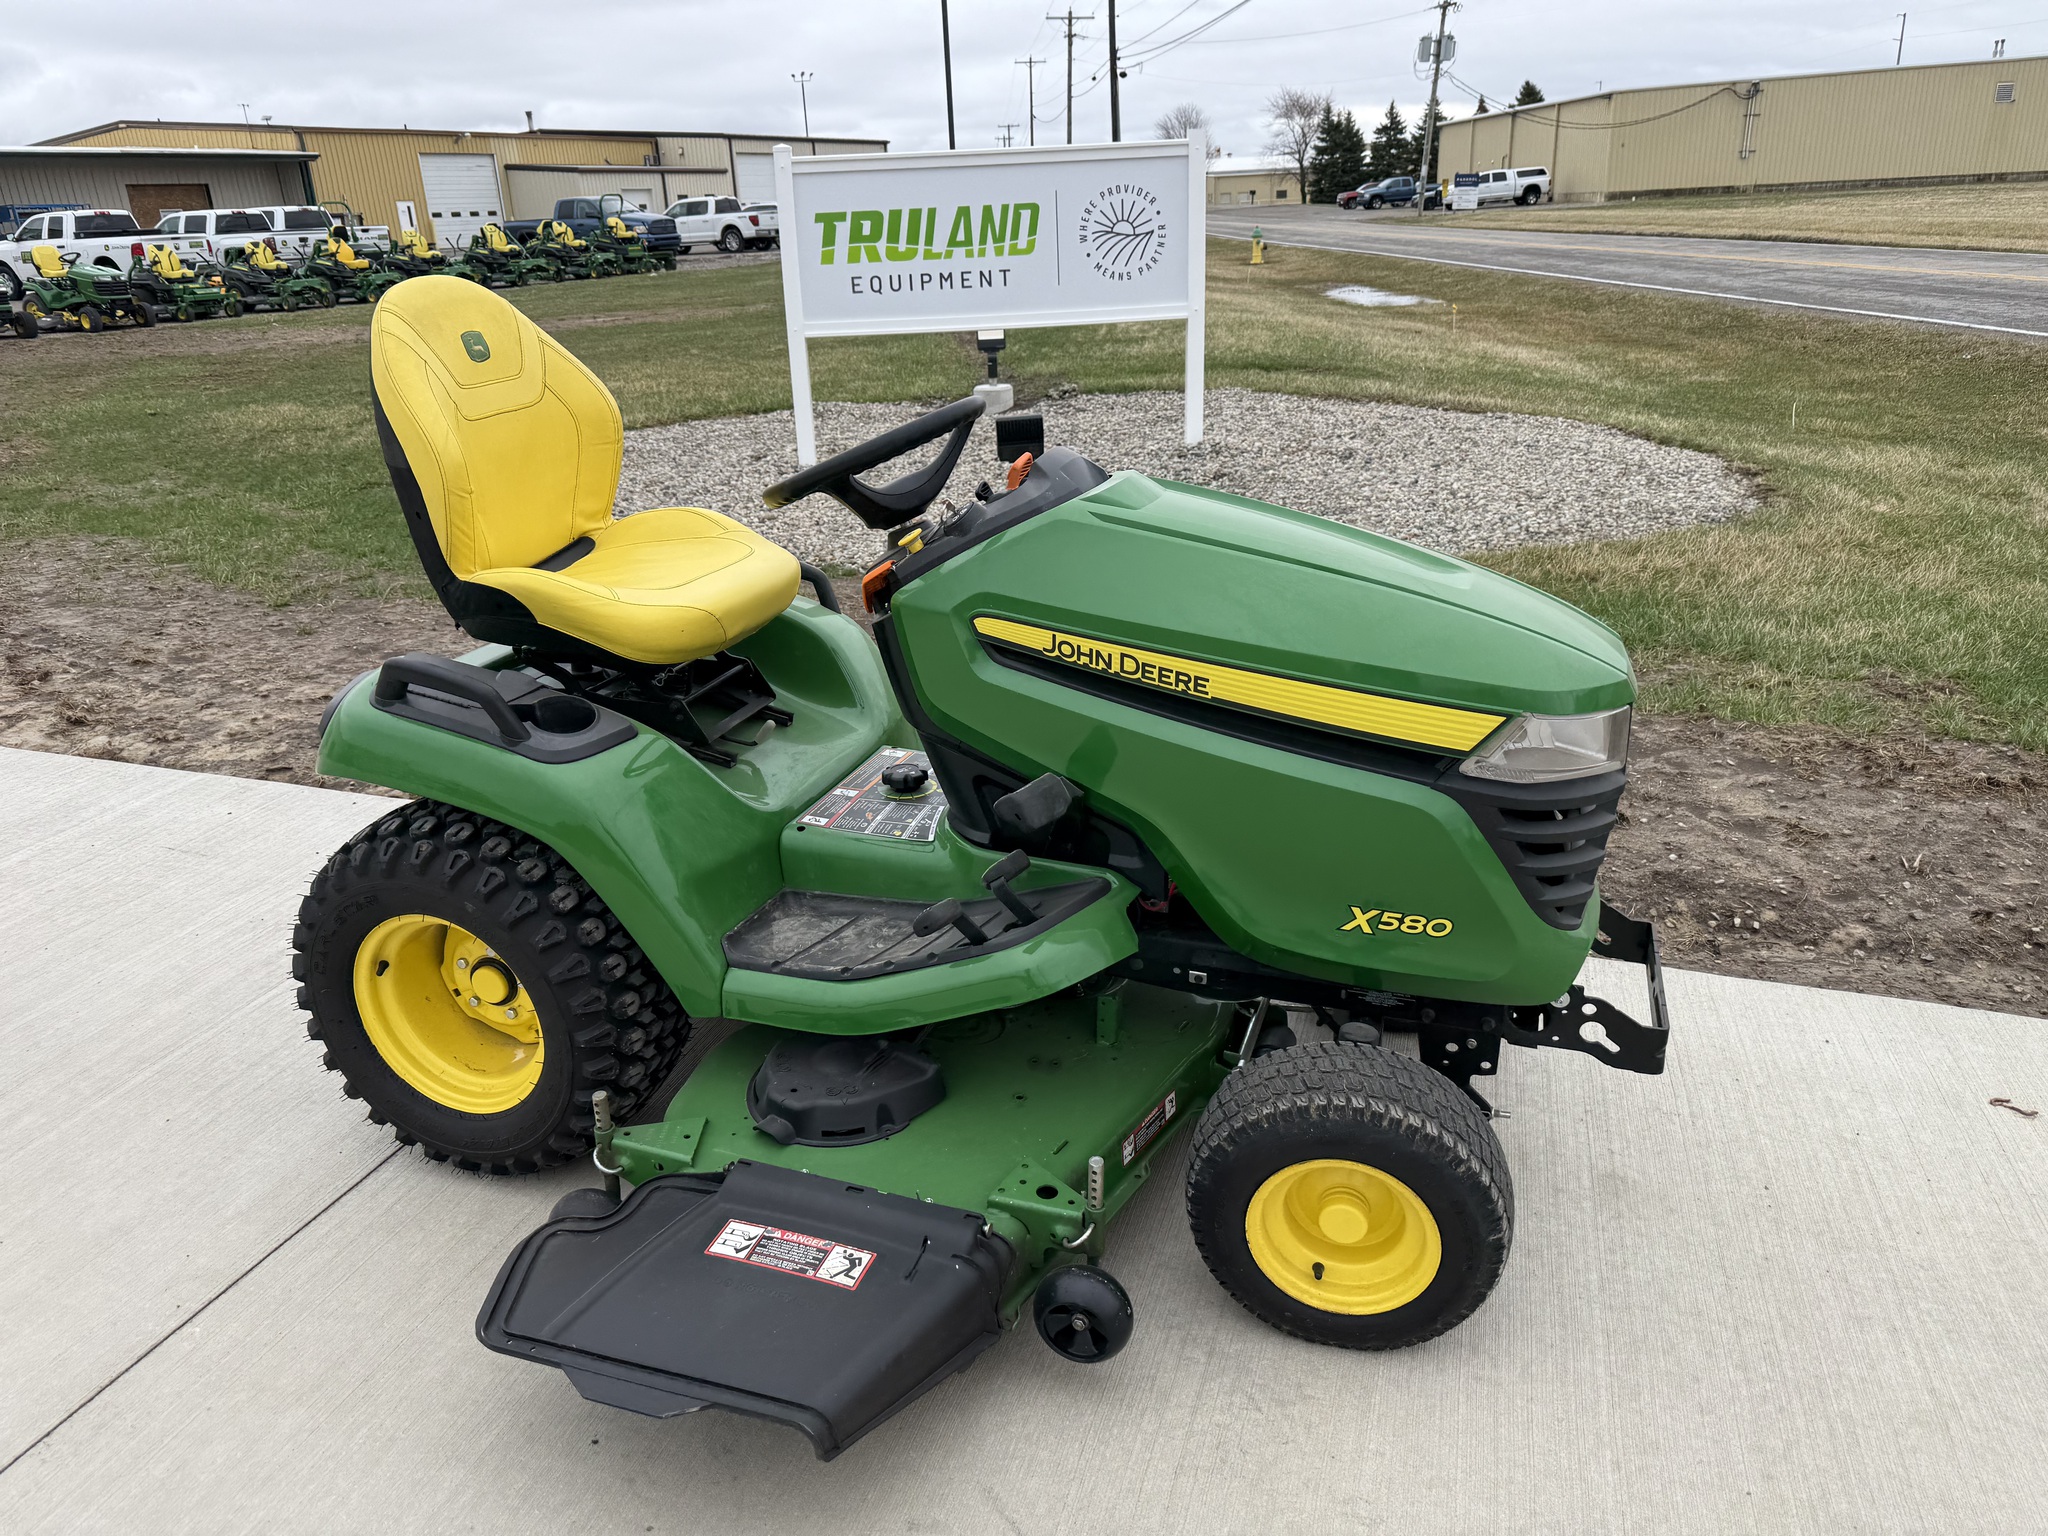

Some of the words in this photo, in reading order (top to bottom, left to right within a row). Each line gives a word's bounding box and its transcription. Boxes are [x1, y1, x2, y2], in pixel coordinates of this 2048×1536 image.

[814, 202, 1041, 265] TRULAND
[1079, 200, 1097, 243] WHERE
[1099, 184, 1157, 206] PROVIDER
[1093, 262, 1132, 281] MEANS
[1138, 224, 1166, 276] PARTNER
[851, 269, 1011, 295] EQUIPMENT
[1042, 633, 1113, 671] JOHN
[1120, 652, 1210, 696] DEERE
[1336, 904, 1454, 938] X580
